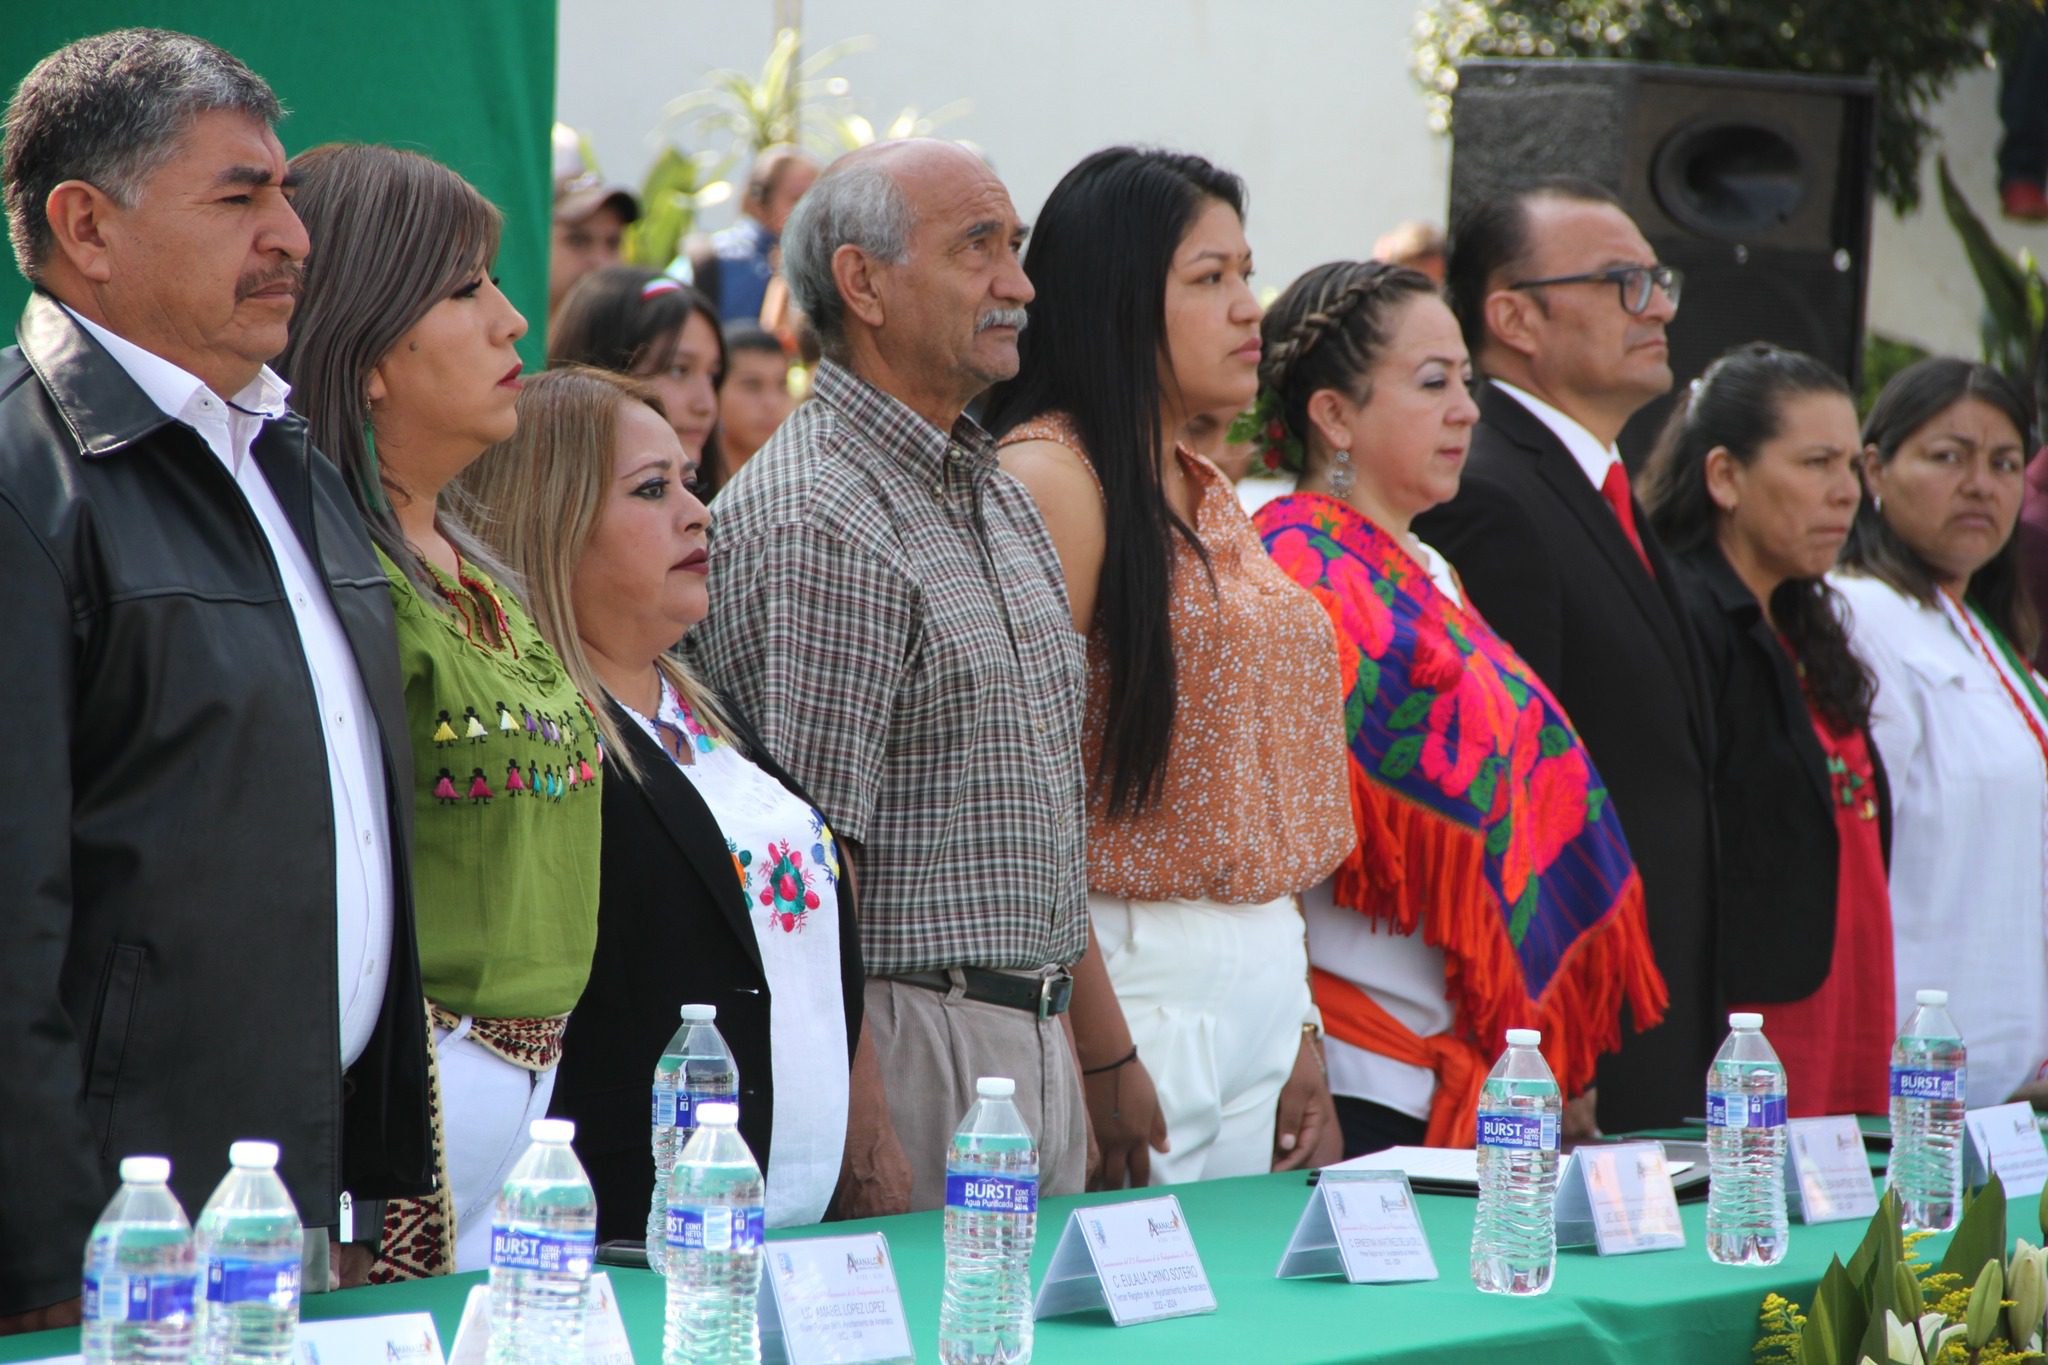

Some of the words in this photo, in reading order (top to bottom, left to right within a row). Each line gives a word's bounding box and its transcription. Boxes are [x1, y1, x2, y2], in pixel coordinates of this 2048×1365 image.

[1901, 1075, 1941, 1090] BURST
[1484, 1121, 1523, 1137] BURST
[1484, 1135, 1495, 1145] Agua
[1495, 1136, 1523, 1145] Purificada
[965, 1182, 1014, 1200] BURST
[964, 1198, 981, 1208] Agua
[981, 1198, 1014, 1209] Purificada
[495, 1236, 540, 1256] BURST
[1120, 1270, 1148, 1288] EULALIA
[1147, 1268, 1171, 1284] CHINO
[1170, 1265, 1199, 1281] SOTERO
[843, 1302, 865, 1316] LOPEZ
[865, 1300, 887, 1314] LOPEZ
